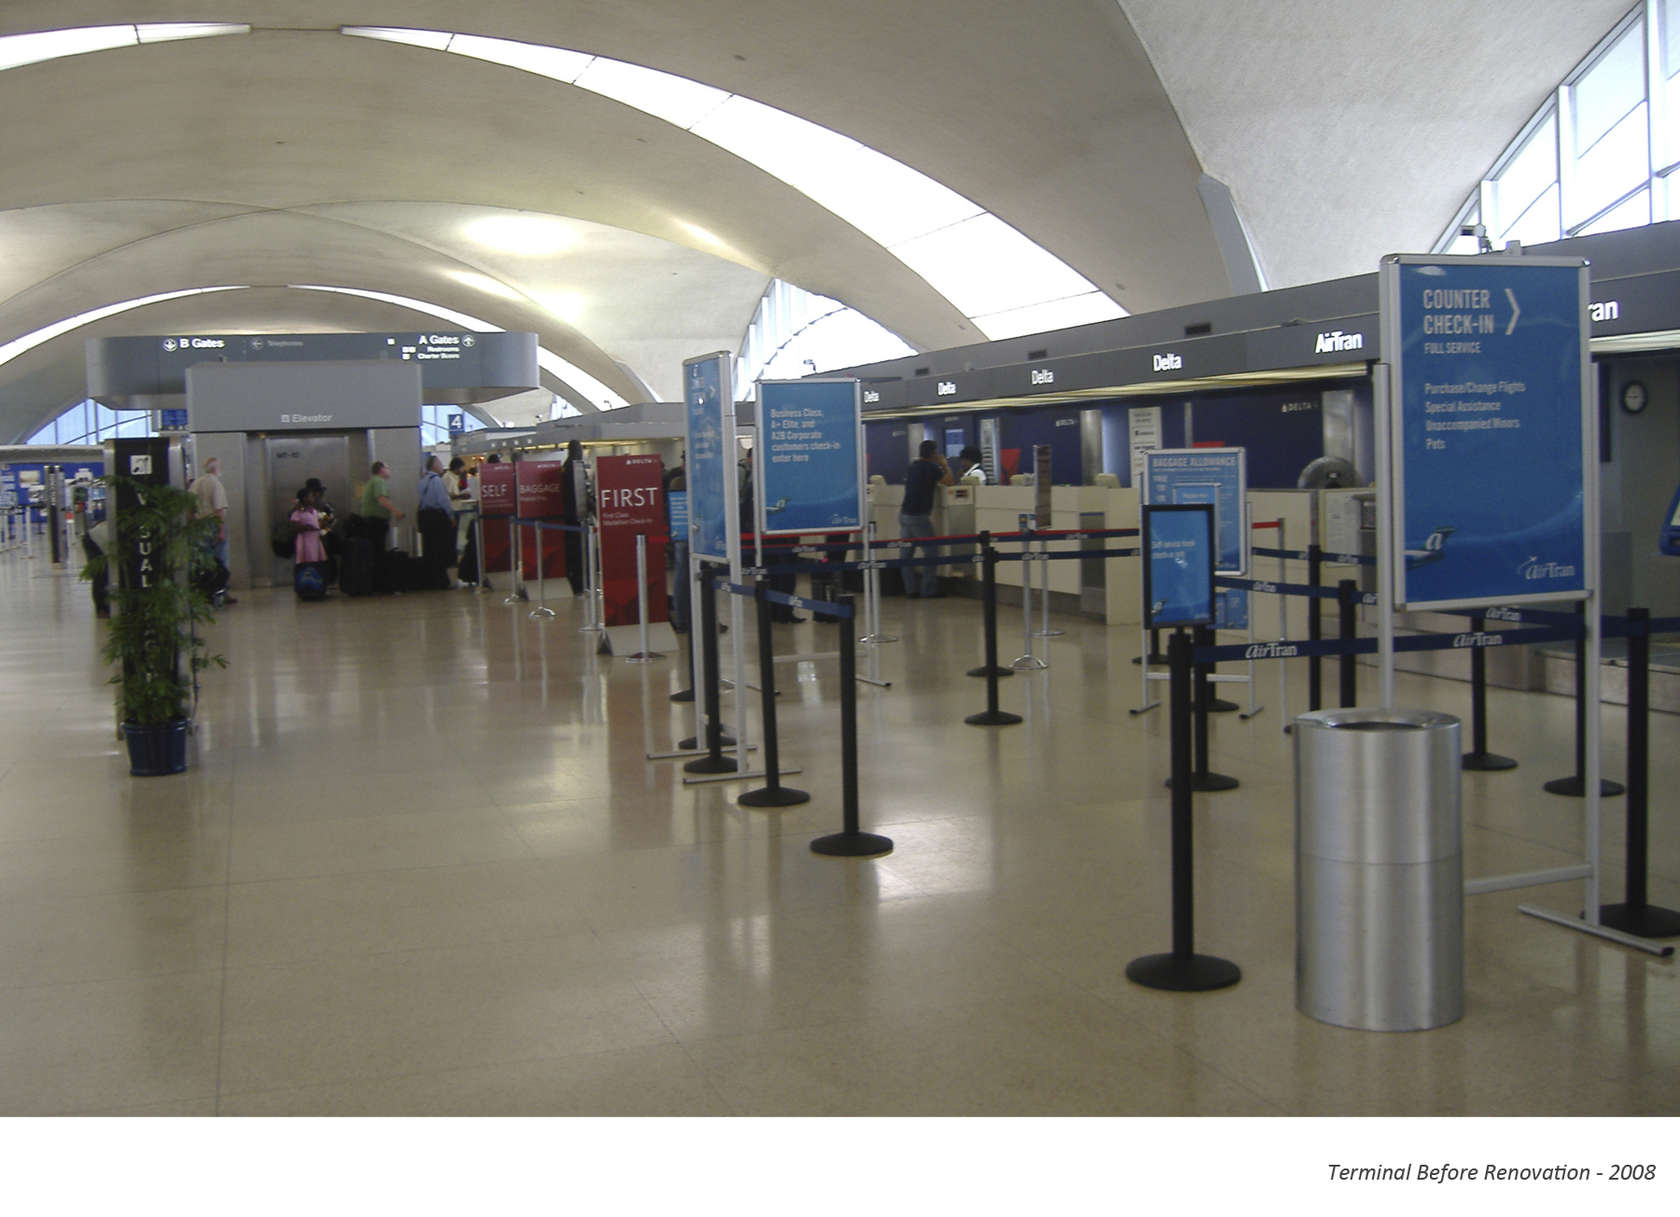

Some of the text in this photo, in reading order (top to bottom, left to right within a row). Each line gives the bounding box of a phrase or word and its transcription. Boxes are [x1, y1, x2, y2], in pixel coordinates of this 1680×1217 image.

[1423, 289, 1491, 309] COUNTER
[1588, 301, 1618, 322] an
[1423, 314, 1495, 335] CHECK-IN
[179, 338, 224, 348] B Gates
[419, 334, 459, 344] A Gates
[1315, 331, 1363, 354] AirTran
[1424, 342, 1481, 354] FULL SERVICE
[1153, 353, 1182, 371] Delta
[1031, 369, 1054, 385] Delta
[937, 383, 957, 396] Delta
[1498, 381, 1526, 394] Flights
[1425, 401, 1501, 414] Special Assistance
[292, 414, 334, 423] Elevator
[451, 415, 462, 429] 4
[1493, 418, 1521, 429] Minors
[1425, 438, 1446, 450] Pets
[481, 484, 507, 498] SELF
[519, 484, 561, 495] BAGGAGE
[601, 487, 658, 508] FIRST
